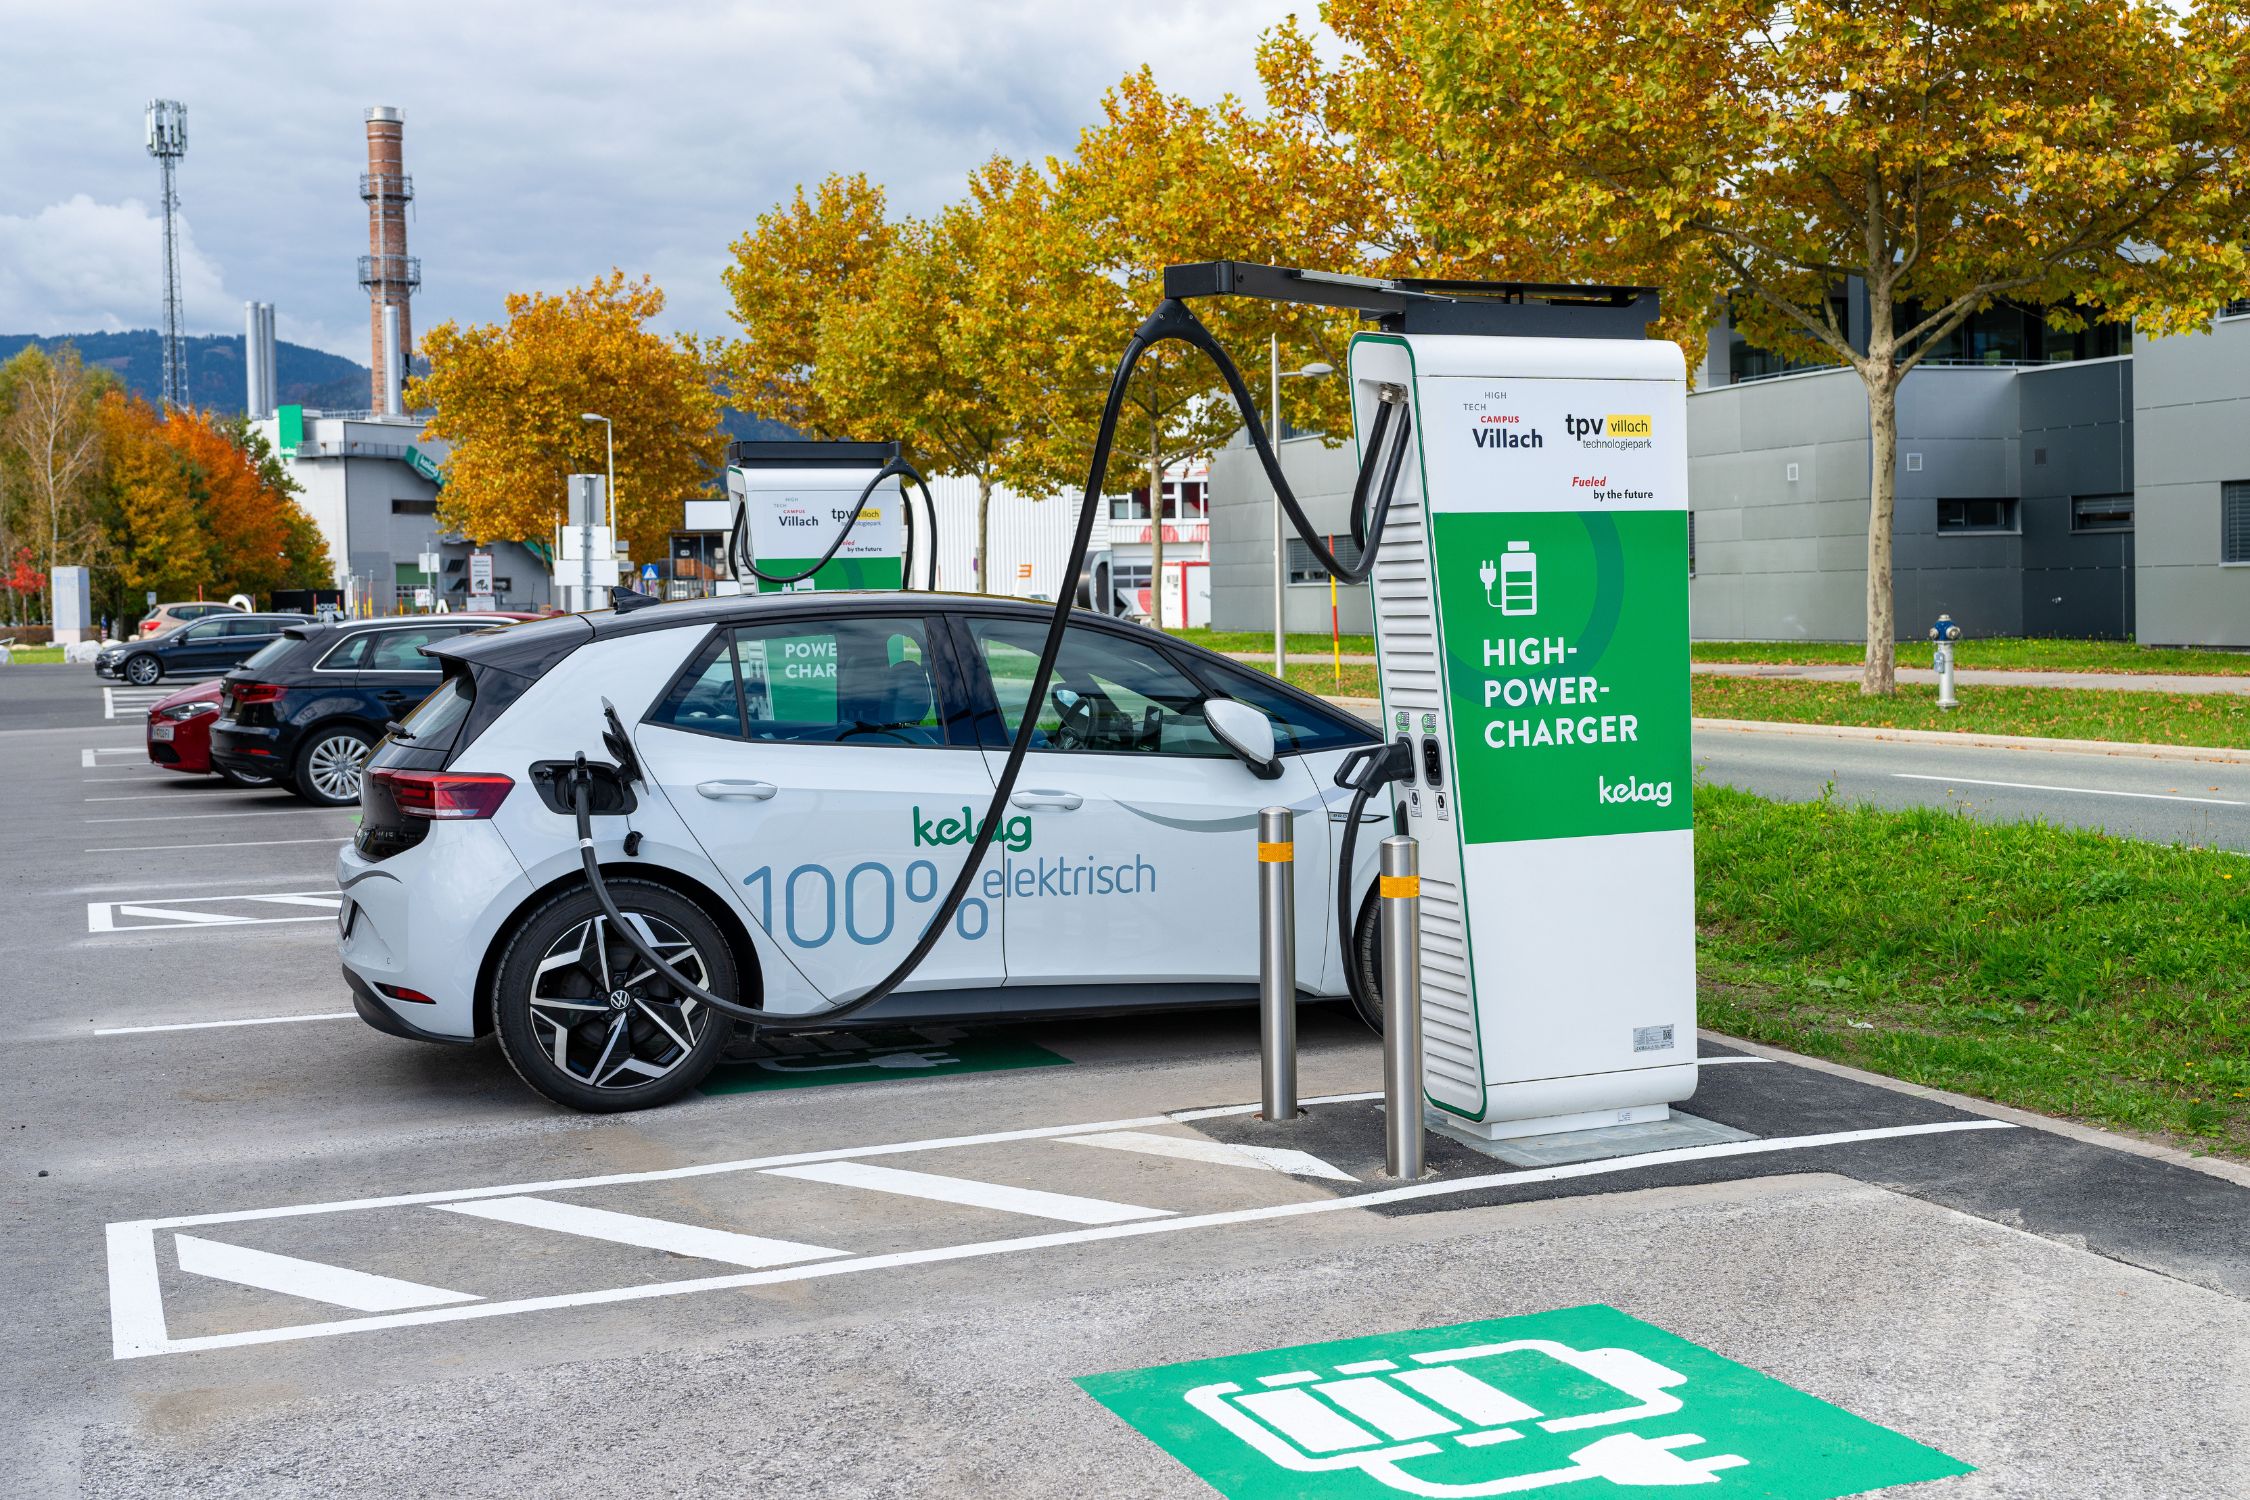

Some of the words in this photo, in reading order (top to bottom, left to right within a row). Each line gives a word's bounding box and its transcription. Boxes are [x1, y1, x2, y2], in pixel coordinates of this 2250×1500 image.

[1472, 429, 1543, 448] Villach
[1566, 414, 1603, 441] tpv
[1611, 421, 1648, 433] villach
[1583, 439, 1651, 450] technologiepark
[1572, 476, 1606, 487] Fueled
[1594, 490, 1604, 501] by
[1607, 490, 1622, 499] the
[1624, 490, 1653, 498] future
[779, 516, 818, 526] Villach
[832, 508, 854, 522] tpv
[1483, 637, 1577, 666] HIGH-
[1484, 676, 1610, 707] POWER-
[1484, 715, 1638, 748] CHARGER
[1599, 775, 1672, 806] kelag
[743, 860, 989, 949] 100%
[983, 854, 1156, 899] elektrisch
